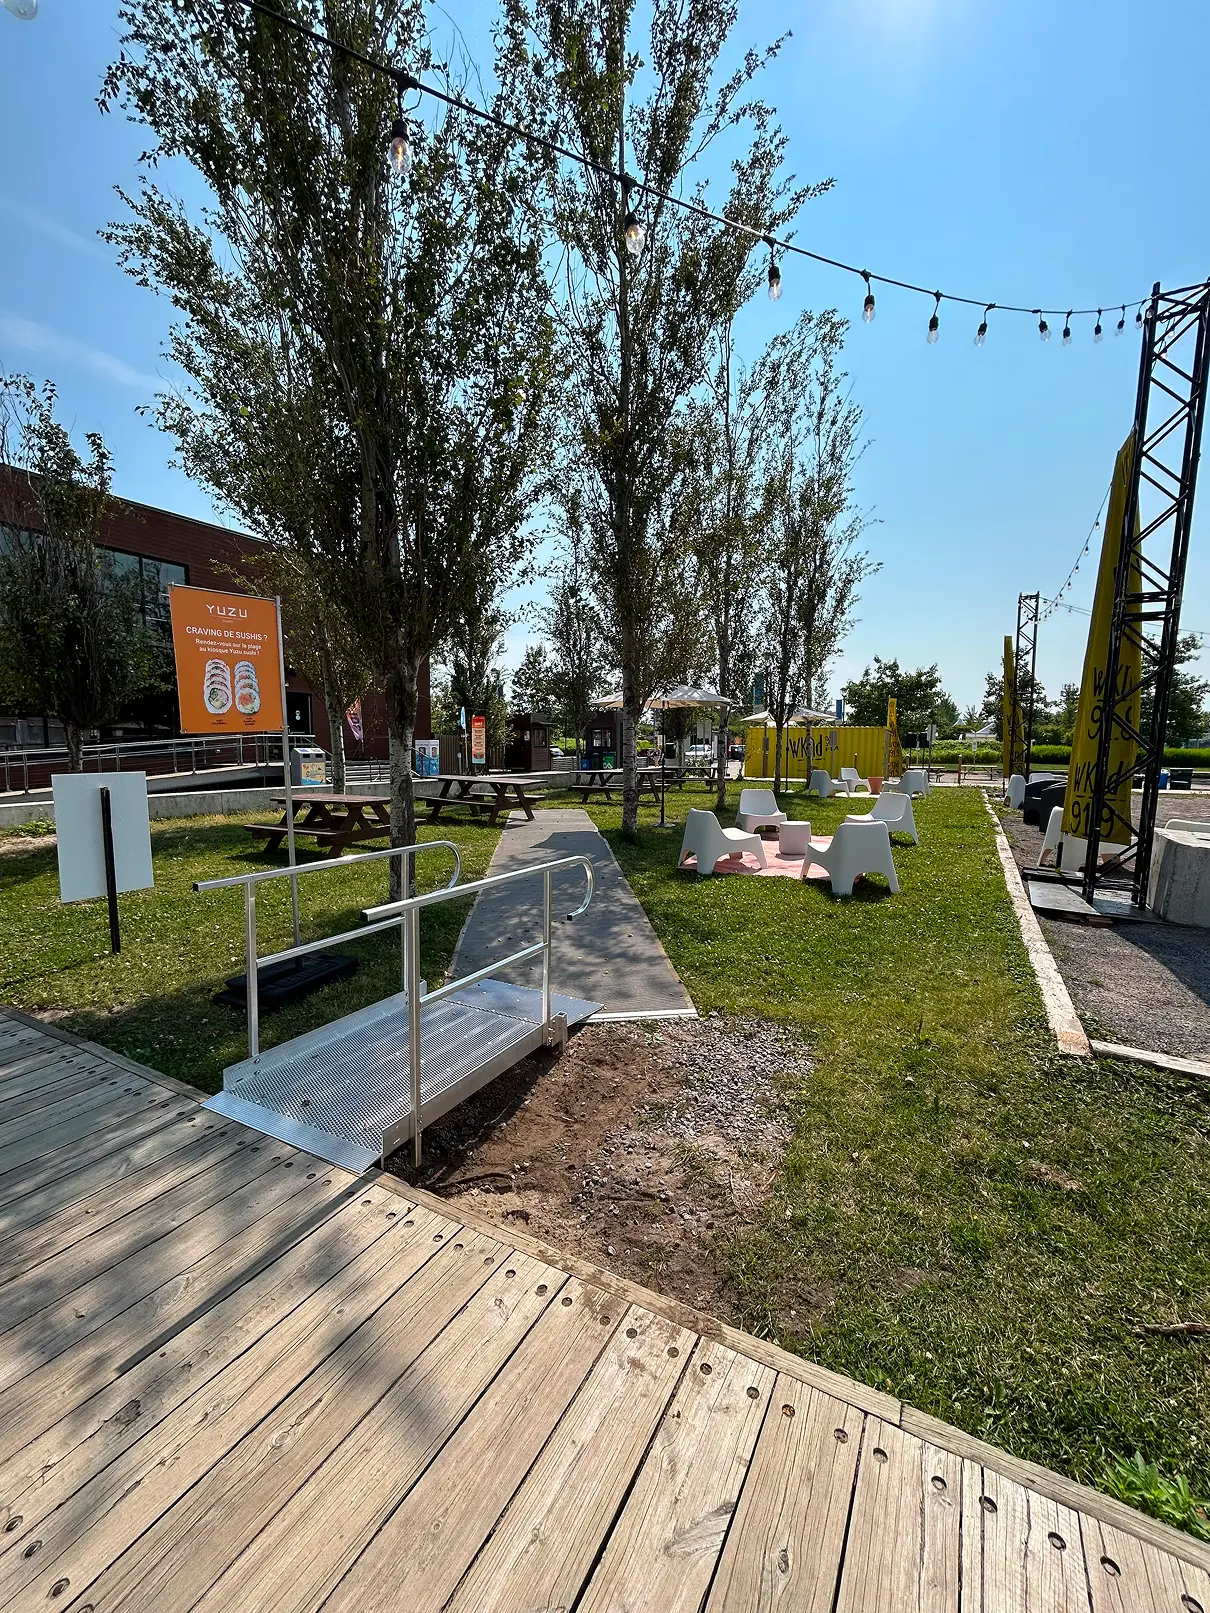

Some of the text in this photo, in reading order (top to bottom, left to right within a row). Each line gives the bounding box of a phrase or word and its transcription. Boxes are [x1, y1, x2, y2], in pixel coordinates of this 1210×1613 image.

[206, 604, 248, 618] YUZU
[185, 626, 222, 637] CRAVING
[224, 630, 235, 638] DE
[235, 631, 262, 641] SUSHIS
[195, 638, 232, 647] Rendez-vous
[207, 646, 229, 655] kiosque
